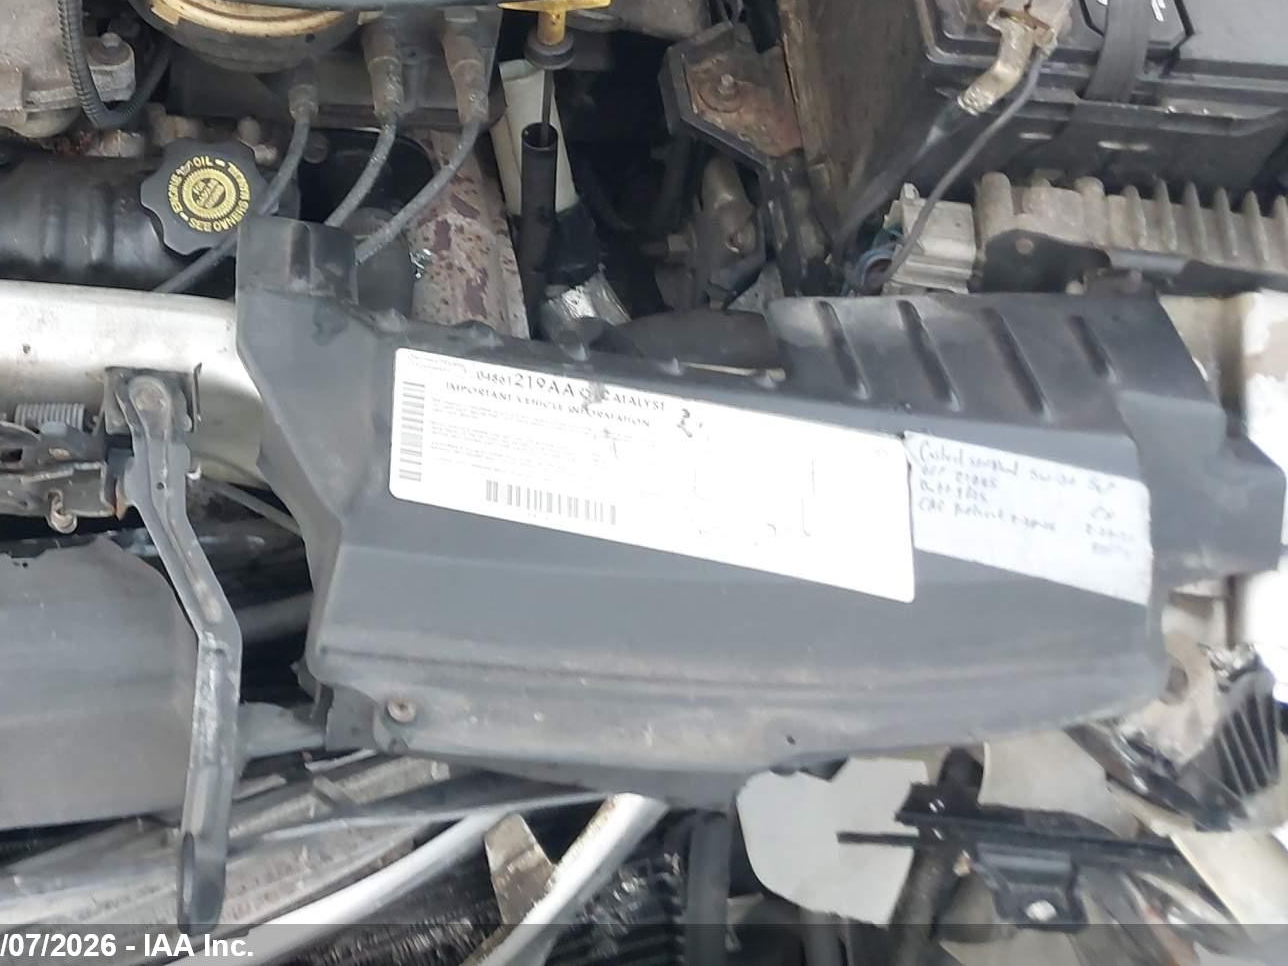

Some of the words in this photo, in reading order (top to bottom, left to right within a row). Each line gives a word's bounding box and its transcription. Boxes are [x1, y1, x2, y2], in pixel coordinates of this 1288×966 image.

[192, 156, 214, 168] OIL
[445, 381, 512, 403] IMPORTANT
[601, 387, 665, 412] CATALYST
